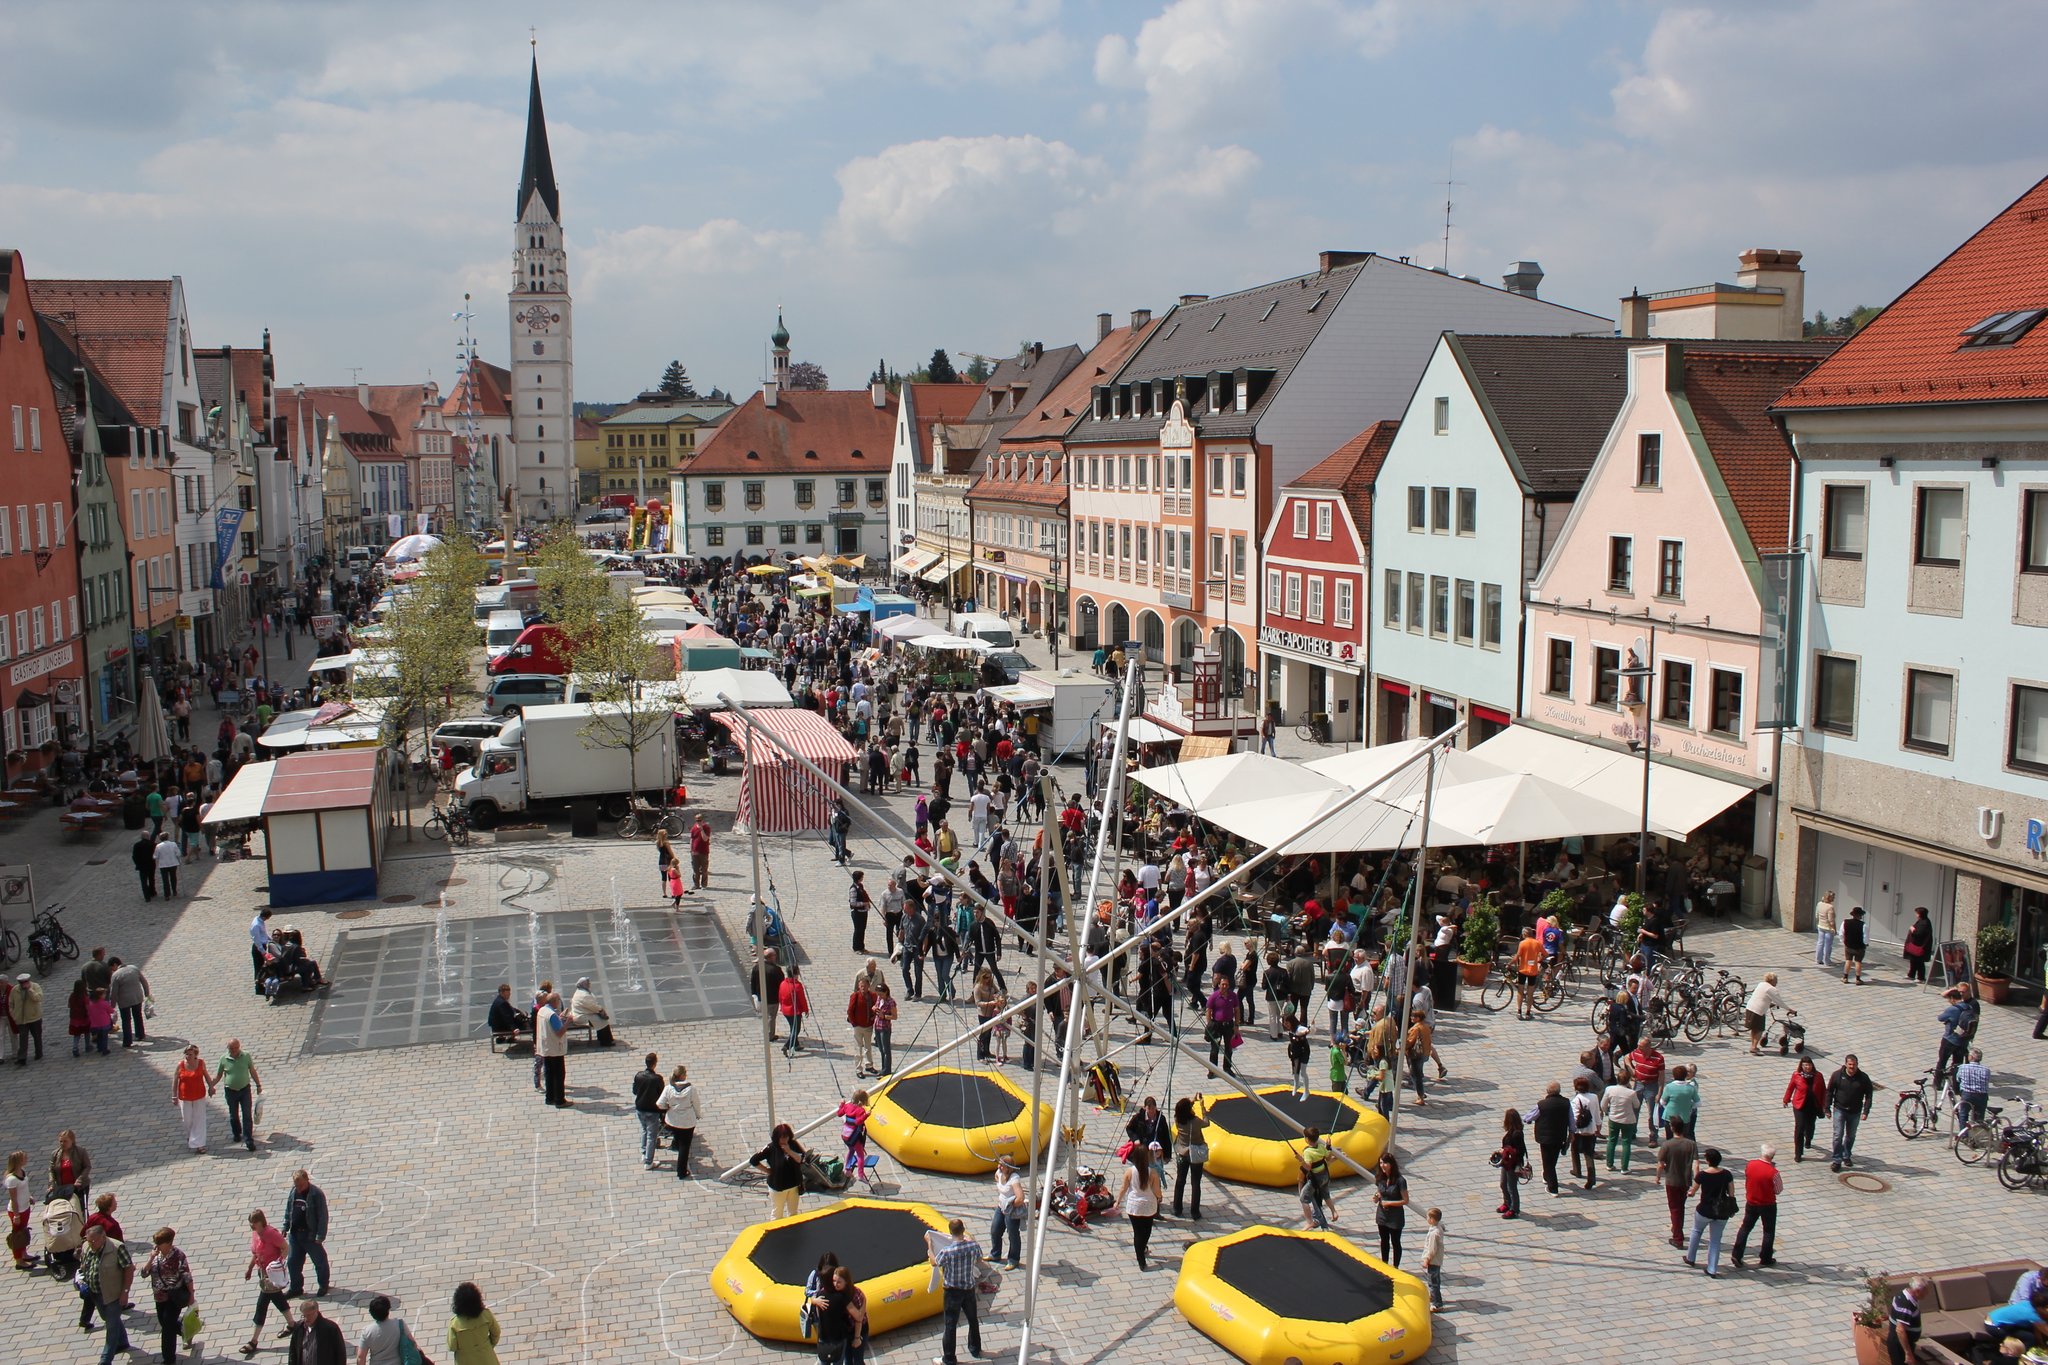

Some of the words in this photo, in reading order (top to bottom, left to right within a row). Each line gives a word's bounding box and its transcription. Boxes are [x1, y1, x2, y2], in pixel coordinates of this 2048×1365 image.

[1260, 626, 1332, 657] MARKT-APOTHEKE
[13, 659, 40, 682] GASTHOF
[1543, 705, 1586, 726] Konditorei
[1680, 738, 1746, 767] Wachszieherei
